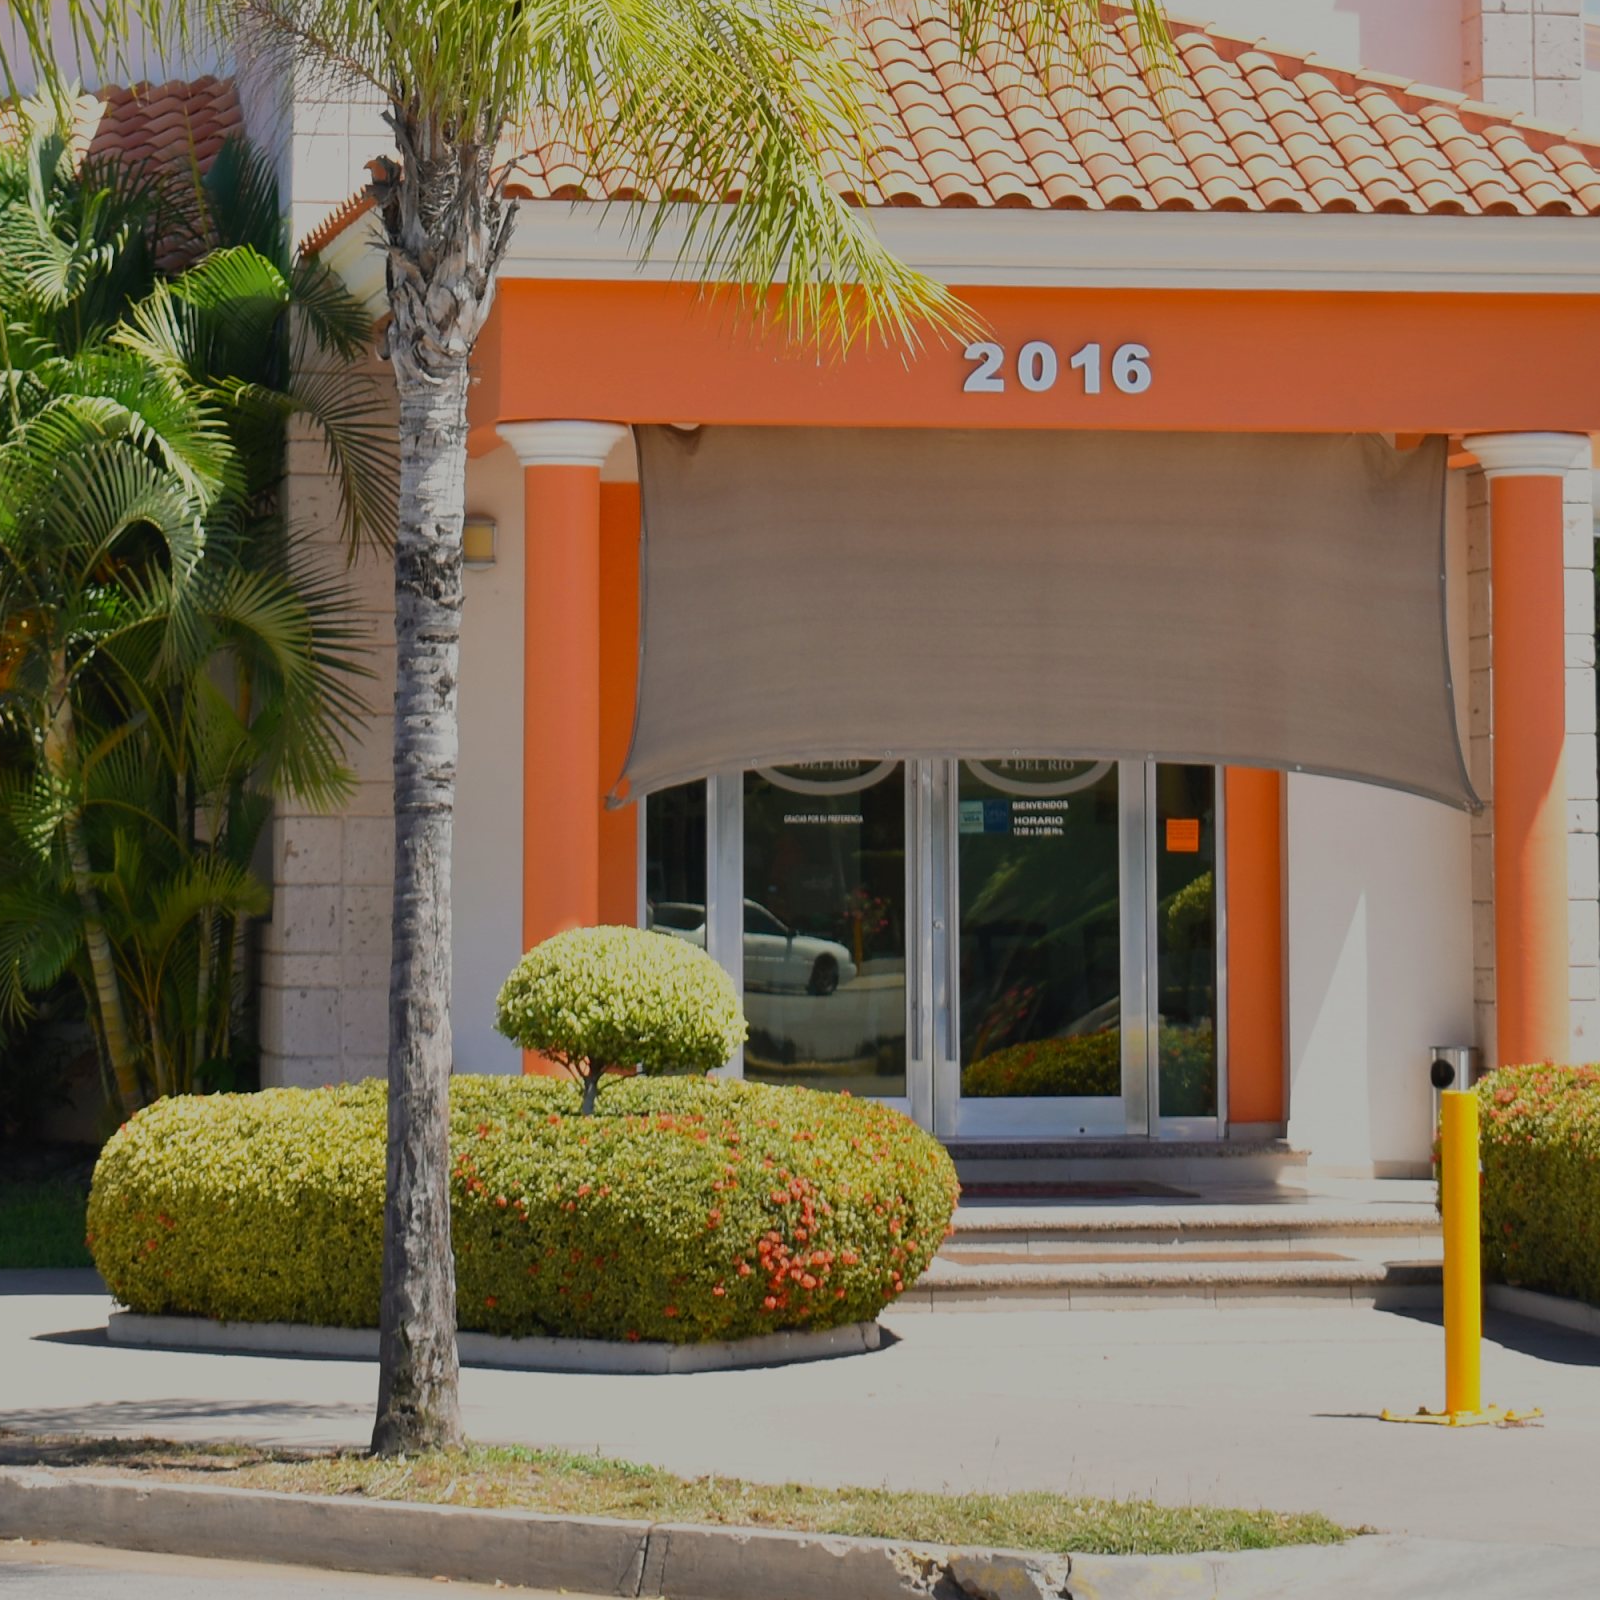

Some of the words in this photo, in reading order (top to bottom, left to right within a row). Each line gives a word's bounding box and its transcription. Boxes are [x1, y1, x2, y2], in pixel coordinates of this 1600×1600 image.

[963, 340, 1153, 395] 2016
[1012, 800, 1069, 810] BIENVENIDOS
[784, 814, 807, 824] GRACIAS
[807, 814, 819, 824] POR
[827, 814, 864, 824] PREFERENCIA
[1013, 816, 1064, 825] HORARIO
